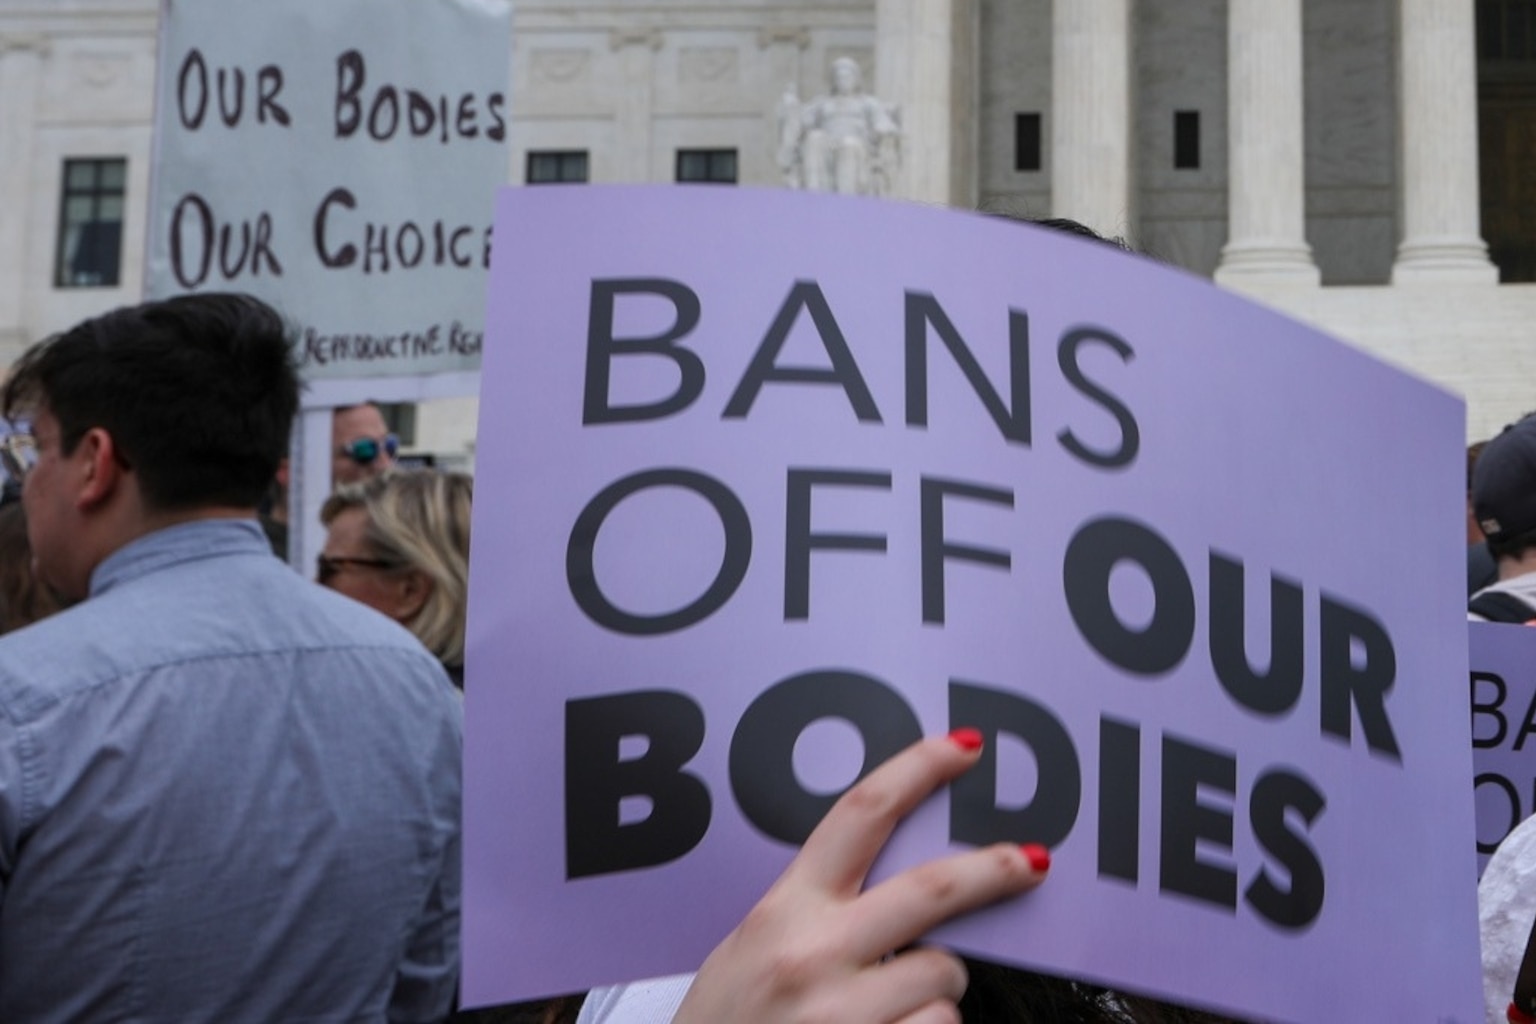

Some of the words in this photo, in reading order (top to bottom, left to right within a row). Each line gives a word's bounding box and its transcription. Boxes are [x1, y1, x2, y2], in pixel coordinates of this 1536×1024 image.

[177, 48, 290, 130] OUR
[335, 49, 505, 143] BODIES
[170, 193, 282, 289] OUR
[582, 277, 1141, 470] BANS
[564, 466, 1014, 637] OFF
[1063, 513, 1403, 767] OUR
[564, 666, 1328, 936] BODIES
